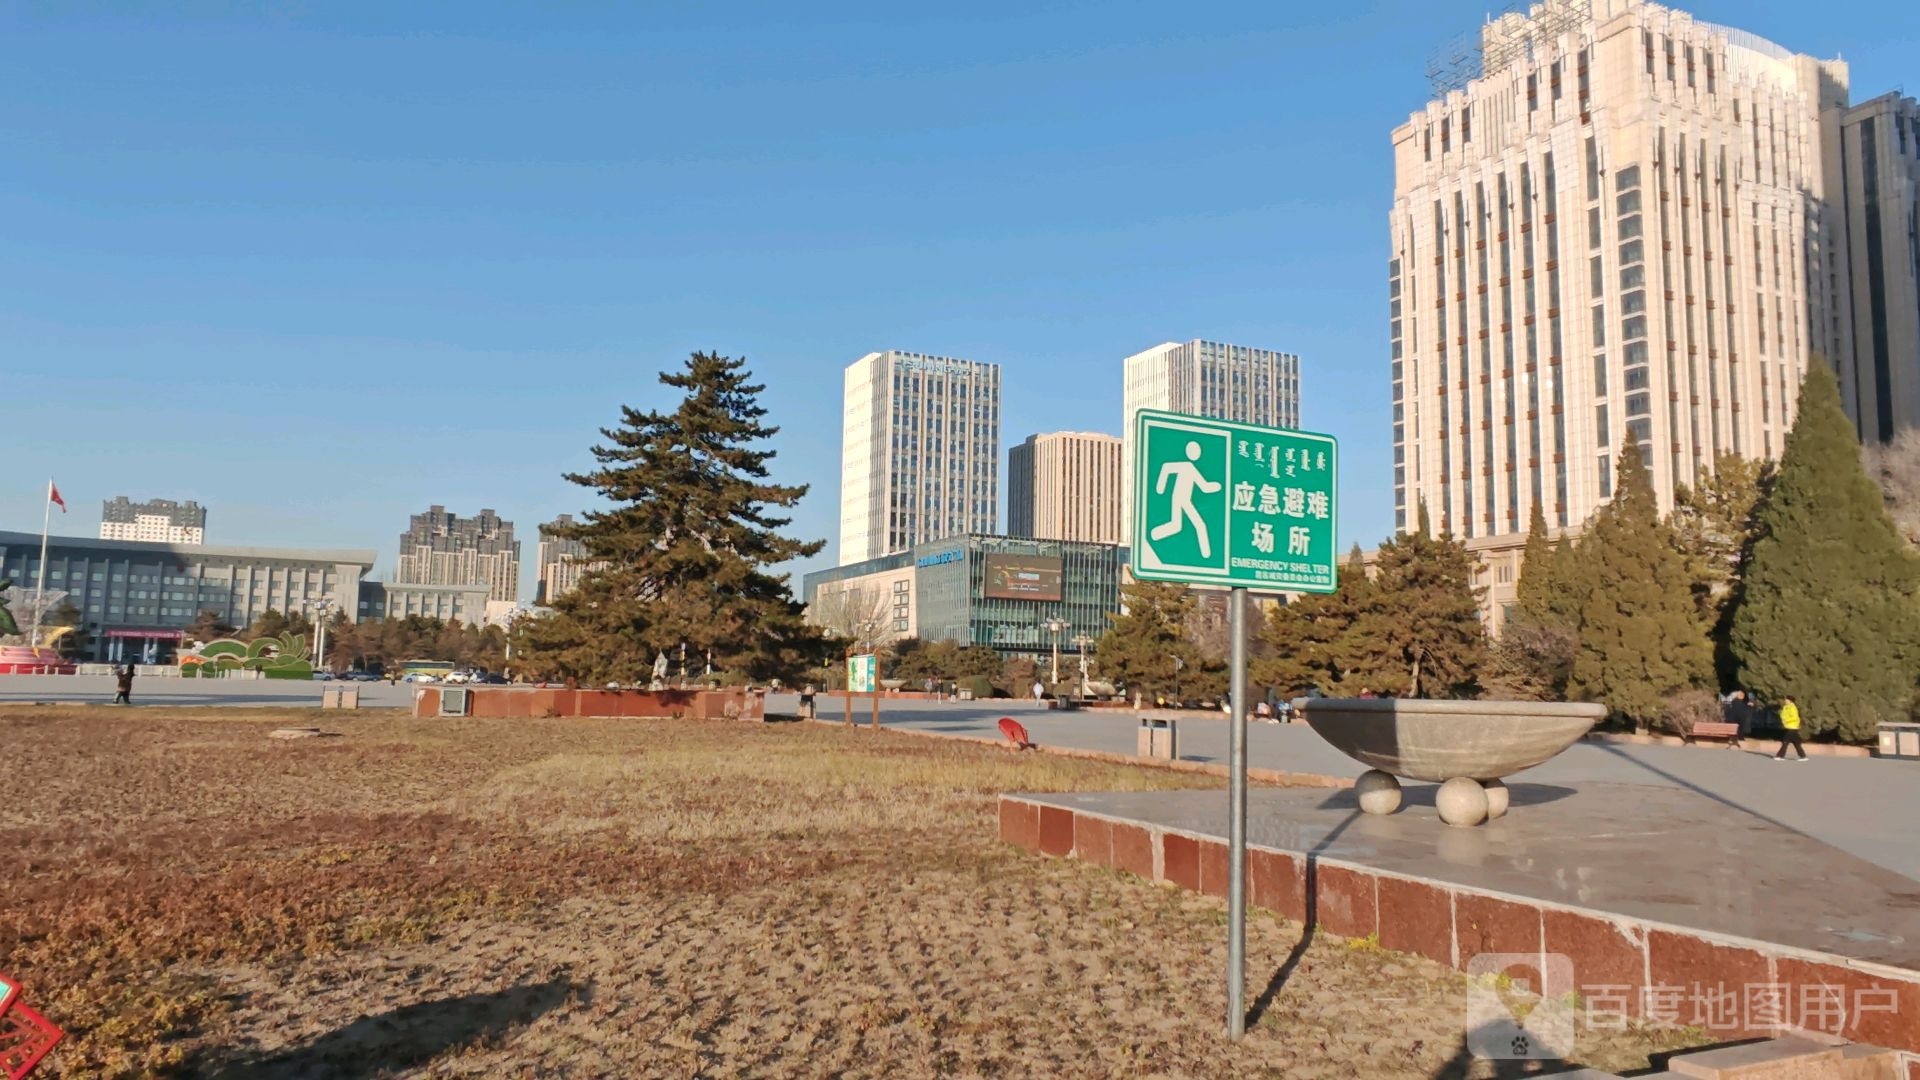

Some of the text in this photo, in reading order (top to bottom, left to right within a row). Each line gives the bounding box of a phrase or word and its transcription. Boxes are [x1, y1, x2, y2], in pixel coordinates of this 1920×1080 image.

[1232, 481, 1329, 520] 应急避难
[1251, 522, 1311, 556] 场所
[1231, 557, 1289, 571] EMERGENCY
